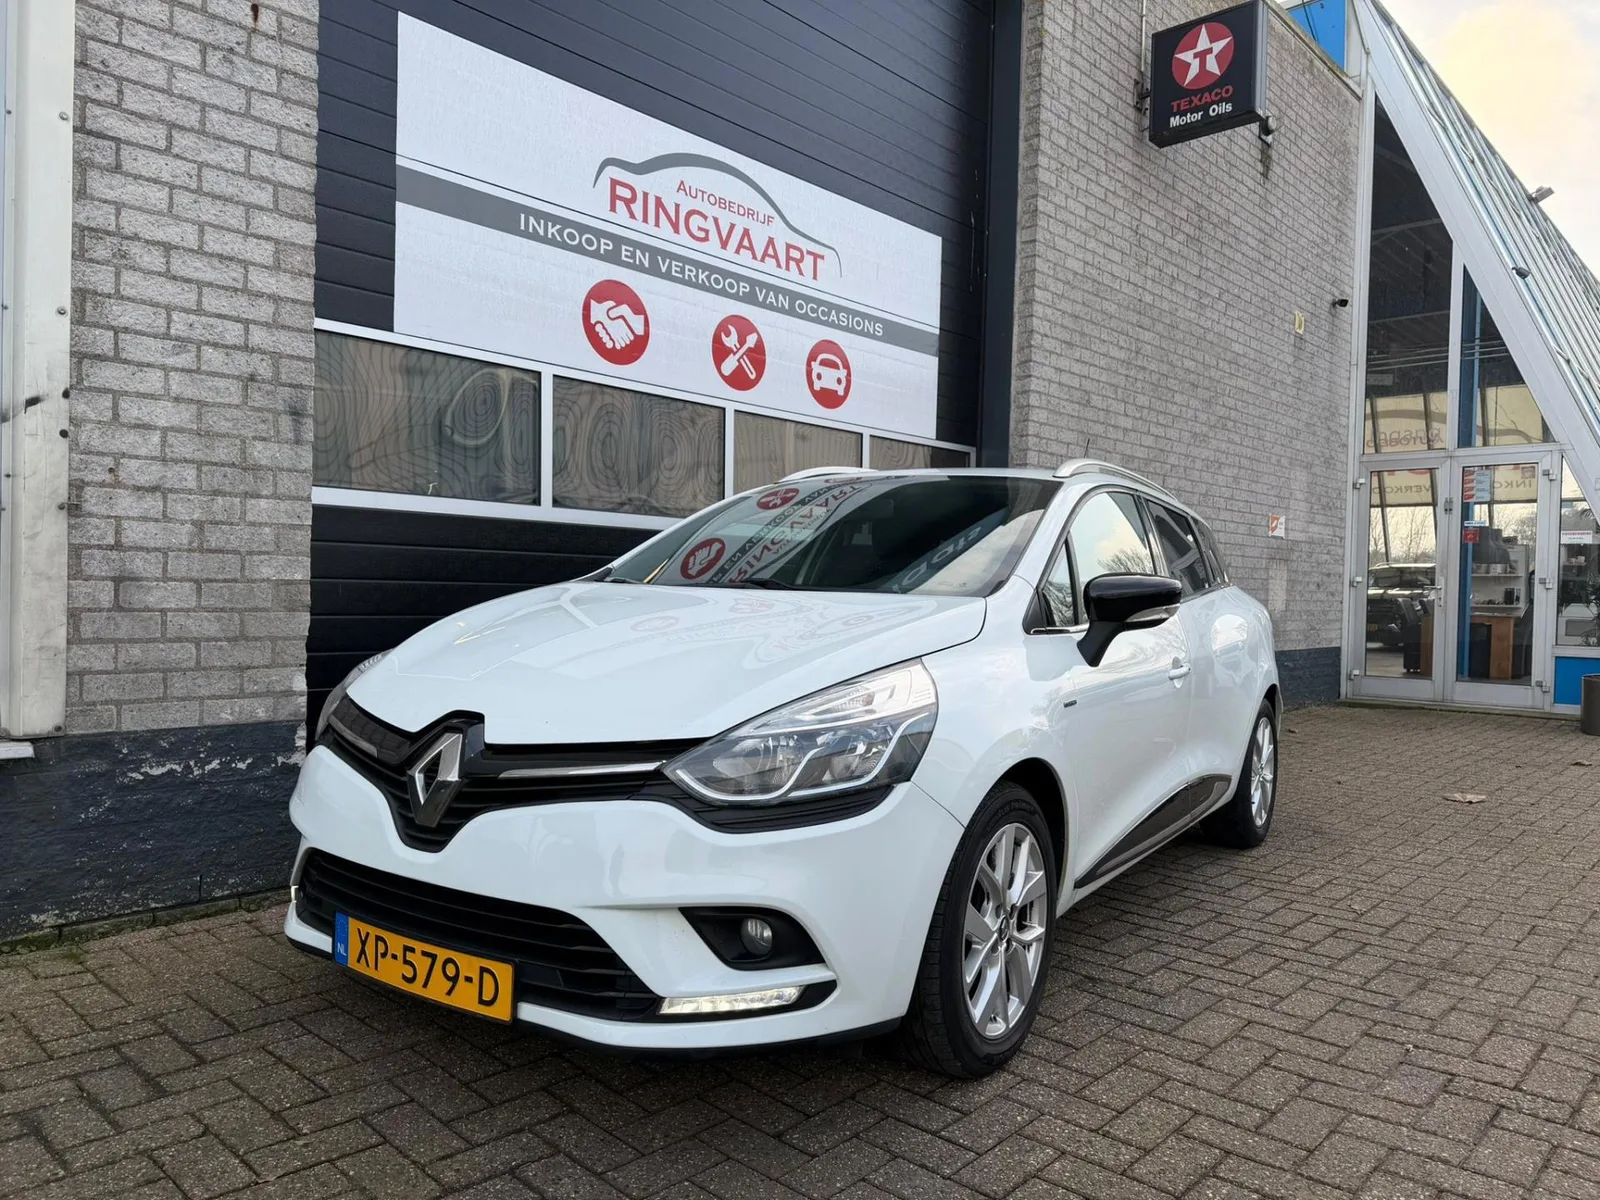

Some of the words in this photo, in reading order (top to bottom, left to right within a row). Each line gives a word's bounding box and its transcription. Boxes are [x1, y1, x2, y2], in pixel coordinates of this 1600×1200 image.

[1169, 110, 1203, 128] Motor
[1209, 102, 1233, 116] Oils
[1171, 85, 1233, 112] TEXACO
[676, 180, 775, 227] AUTOBEDRIJF
[608, 177, 825, 282] RINGVAART
[519, 213, 614, 256] INKOOP
[621, 245, 650, 270] EN
[657, 256, 751, 297] VERKOOP
[755, 286, 790, 311] VAN
[795, 300, 884, 337] OCCASIONS
[337, 942, 347, 956] NL
[356, 927, 500, 1008] XP-579-D
